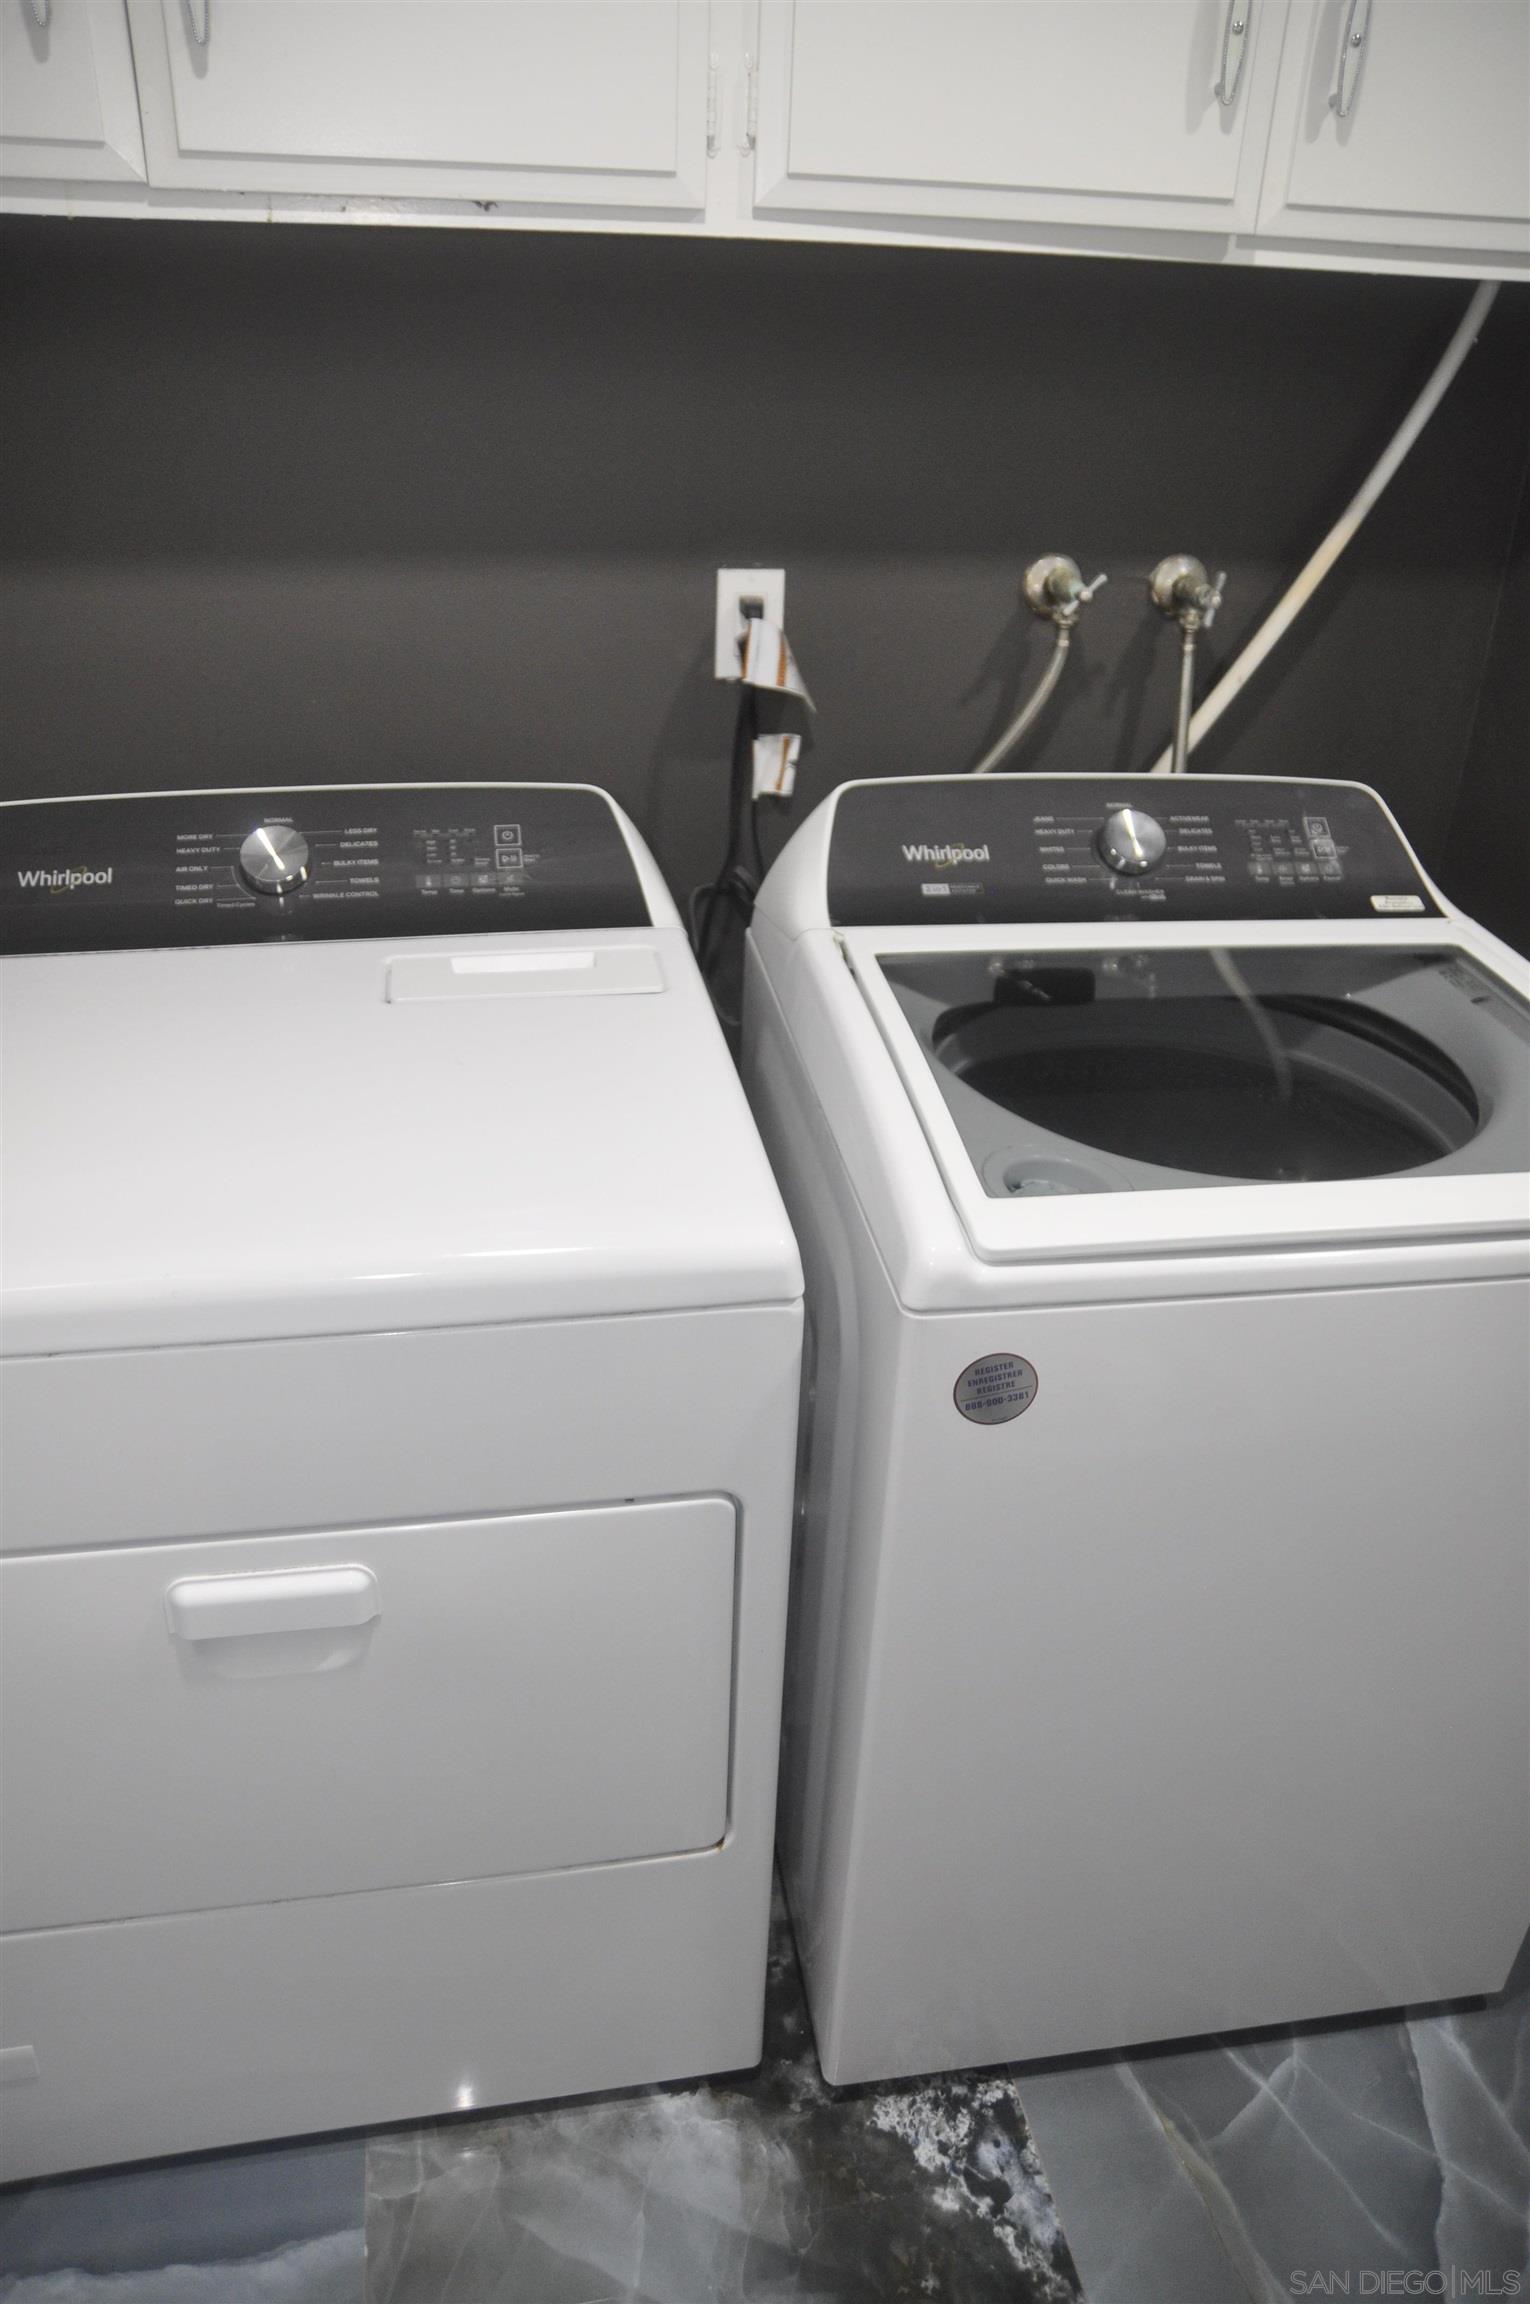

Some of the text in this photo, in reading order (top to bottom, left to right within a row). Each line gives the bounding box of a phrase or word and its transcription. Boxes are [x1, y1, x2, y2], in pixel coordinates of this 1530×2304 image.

[902, 844, 990, 866] Whirlpool
[18, 867, 113, 890] Whirlpool
[974, 1361, 1014, 1376] REGISTER
[967, 1369, 1023, 1387] ENREGISTRER
[977, 1380, 1016, 1395] REGISTRE
